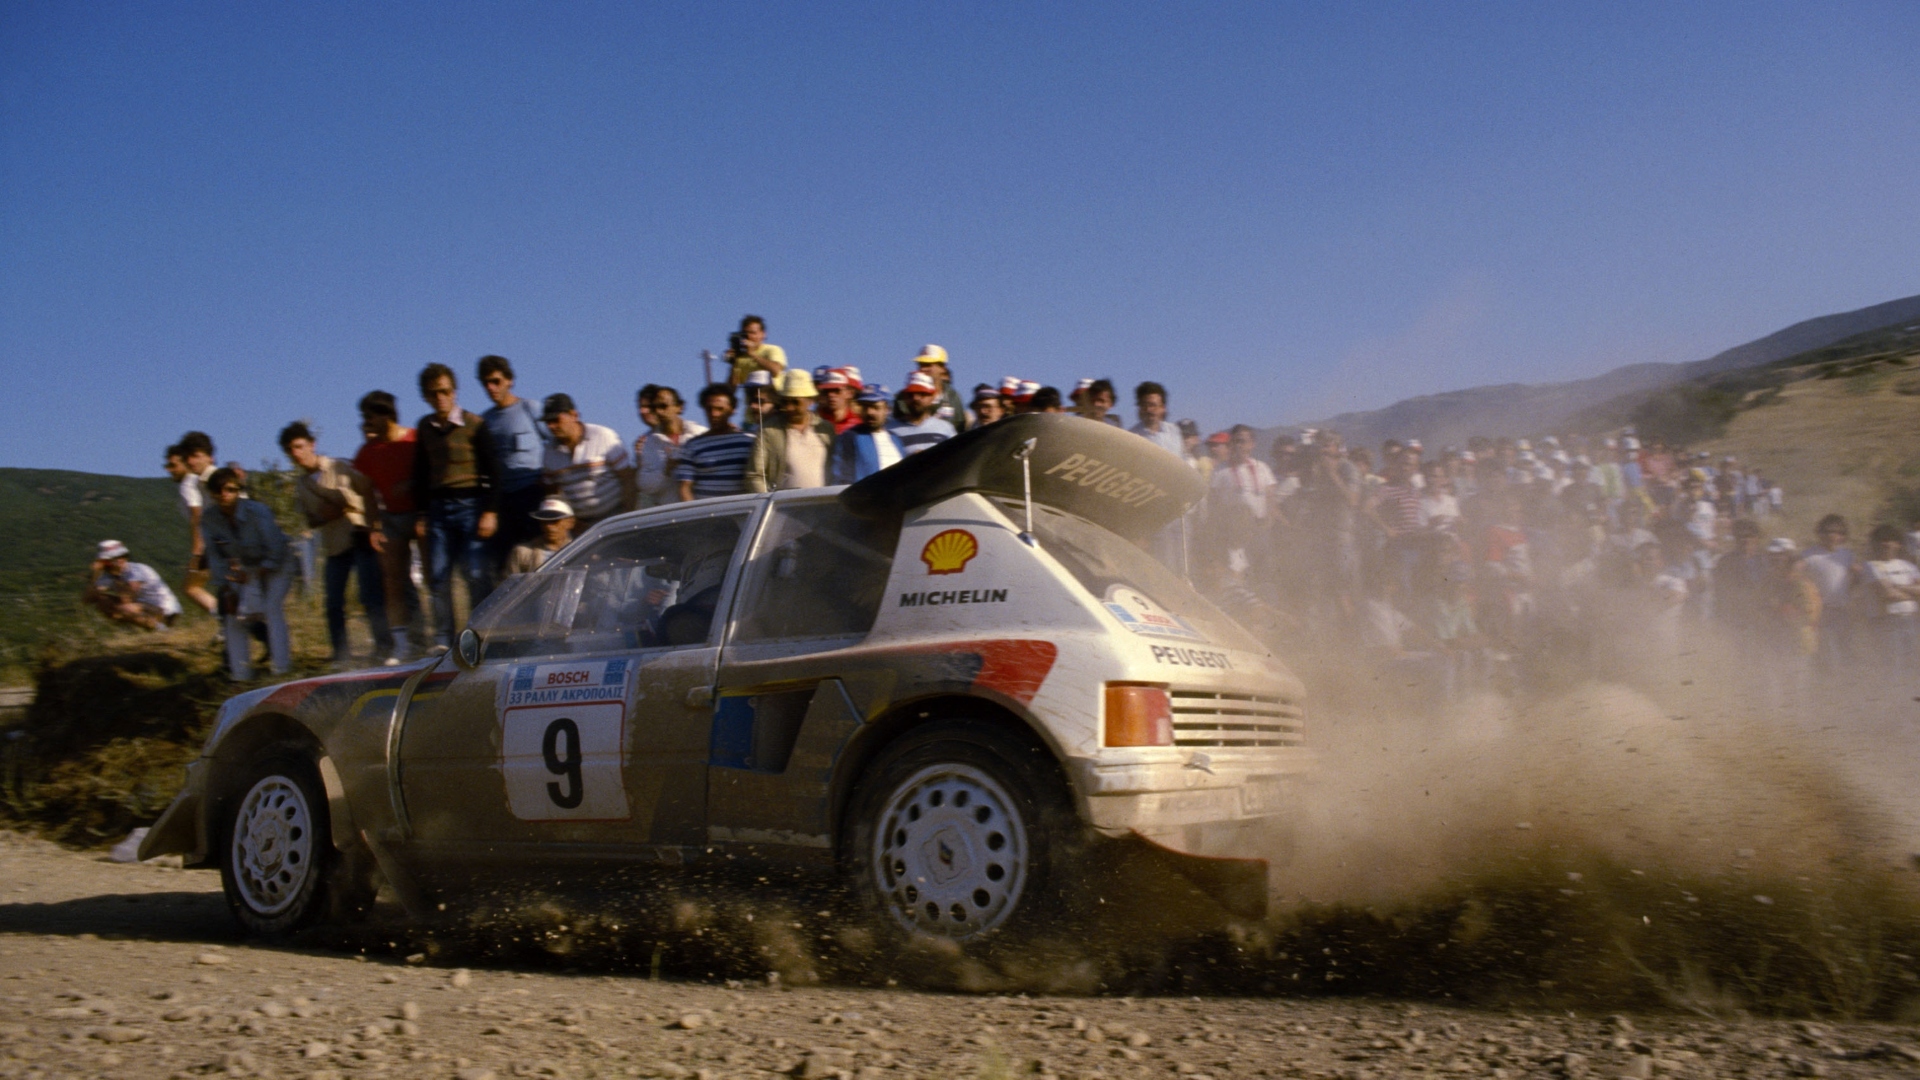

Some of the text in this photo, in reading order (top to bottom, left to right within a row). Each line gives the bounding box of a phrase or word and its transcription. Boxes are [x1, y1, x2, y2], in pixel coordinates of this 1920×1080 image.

[1043, 453, 1167, 507] PEUGEOT
[899, 588, 1008, 607] MICHELIN
[1149, 644, 1234, 670] PEUGEOT
[547, 670, 590, 685] BOSCH
[509, 692, 522, 705] 33
[561, 686, 625, 700] ΑΚΡΟΠΟΛΙΣ
[542, 717, 584, 810] 9
